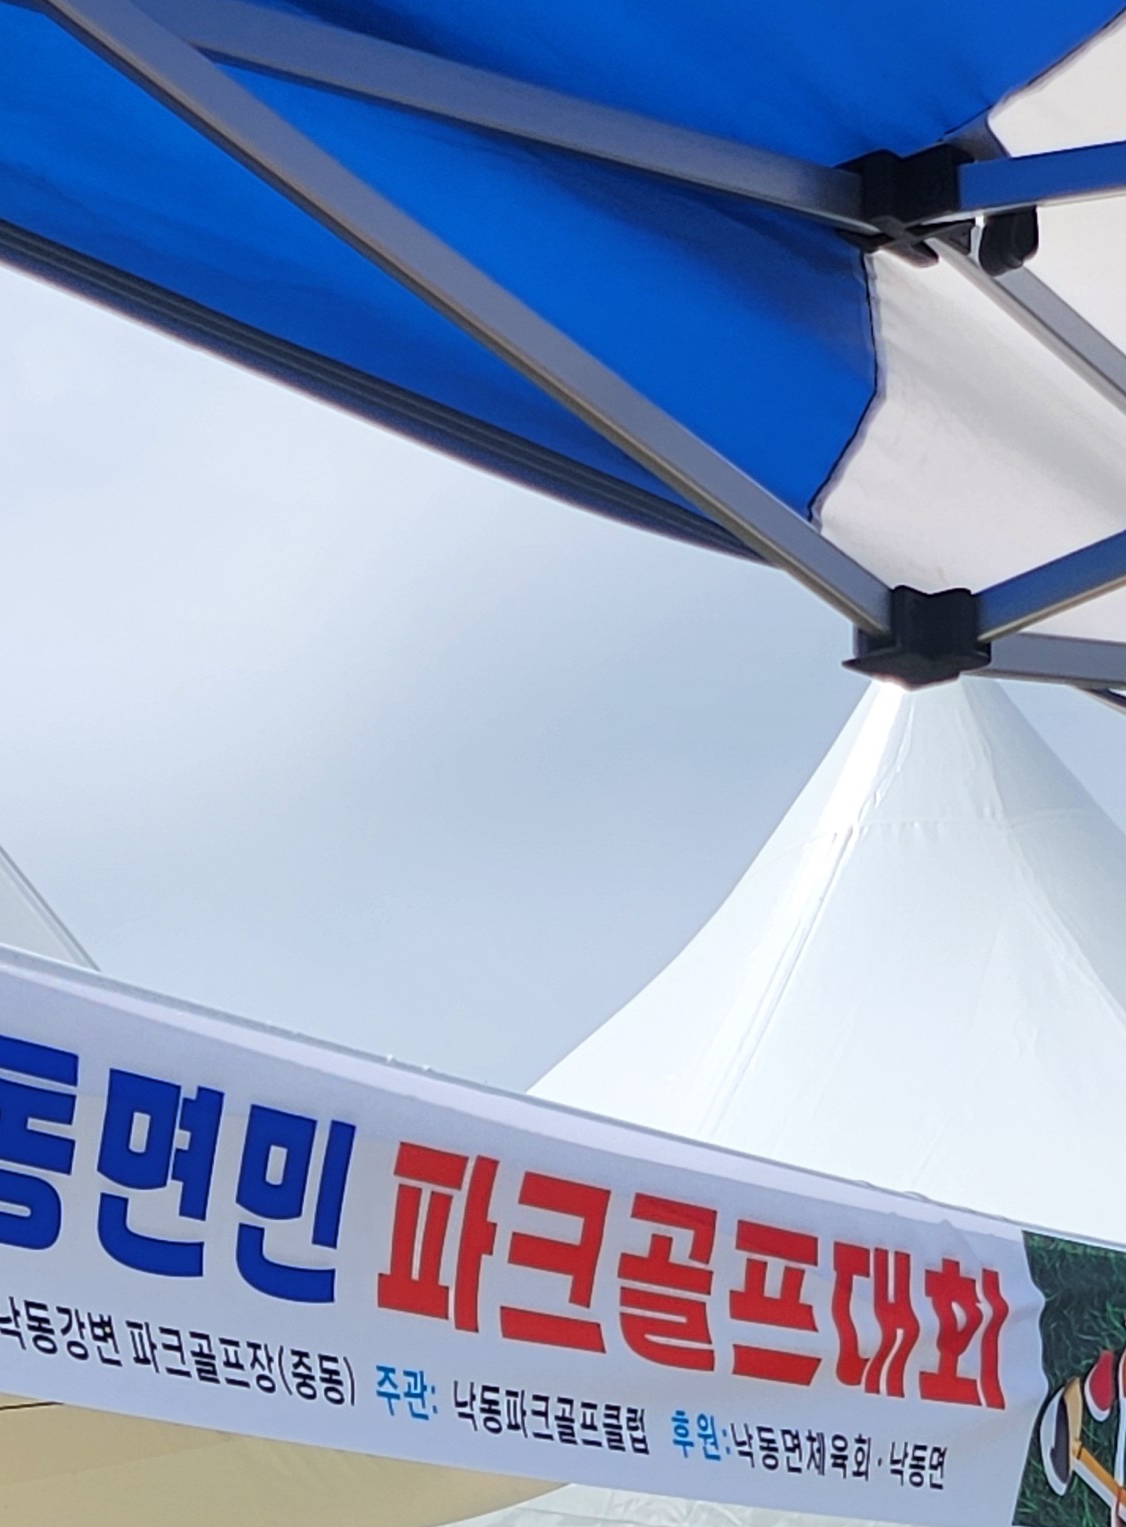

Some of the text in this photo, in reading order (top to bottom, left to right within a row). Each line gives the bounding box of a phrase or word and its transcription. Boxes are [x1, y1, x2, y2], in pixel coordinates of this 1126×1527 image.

[377, 1141, 1010, 1411] 파크골프대회
[125, 1319, 356, 1408] 파크골프장(중동)
[375, 1364, 439, 1422] 주관:
[453, 1380, 651, 1455] 낙동파크골프클럽
